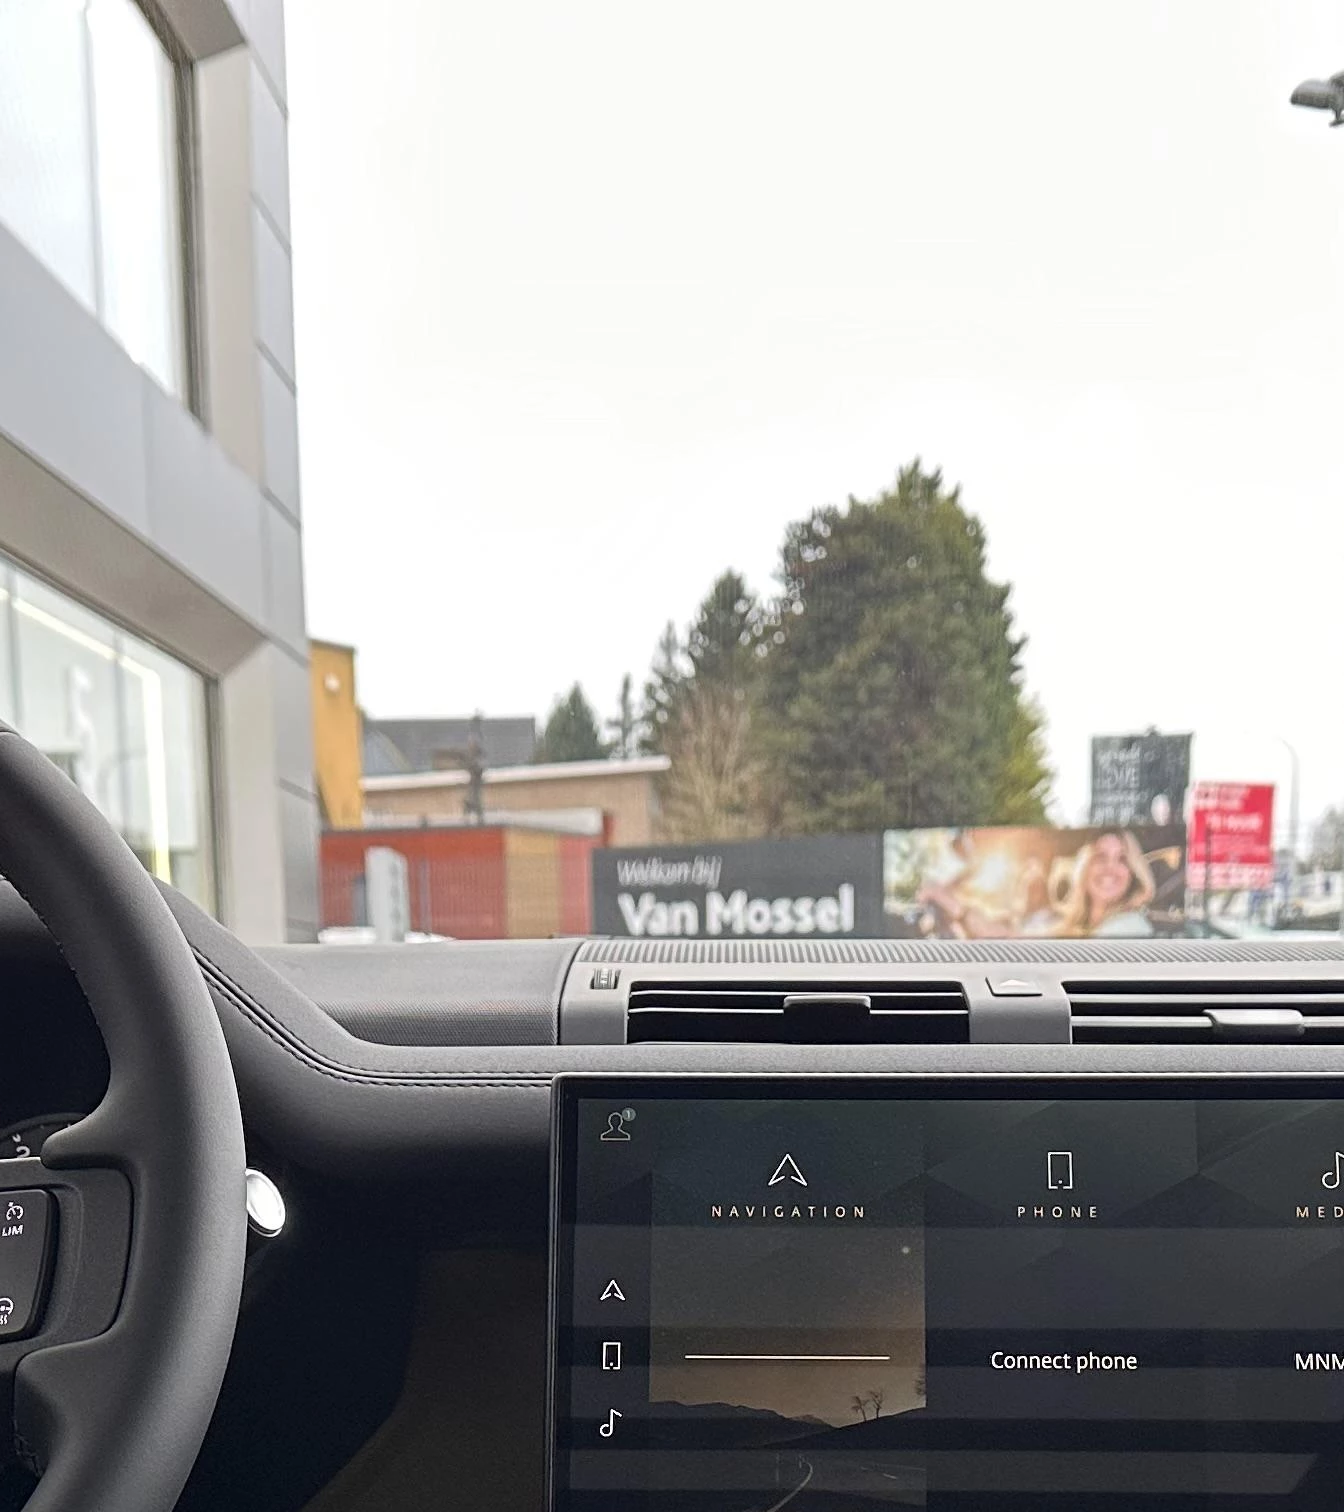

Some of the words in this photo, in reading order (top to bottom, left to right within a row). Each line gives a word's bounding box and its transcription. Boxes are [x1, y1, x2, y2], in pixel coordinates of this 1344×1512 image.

[617, 892, 699, 936] Van
[706, 883, 854, 935] Mossel
[711, 1205, 865, 1219] NAVIGATION
[1017, 1206, 1098, 1219] PHONE
[1, 1225, 24, 1237] LIM
[990, 1351, 1071, 1371] Connect
[1076, 1351, 1138, 1374] phone
